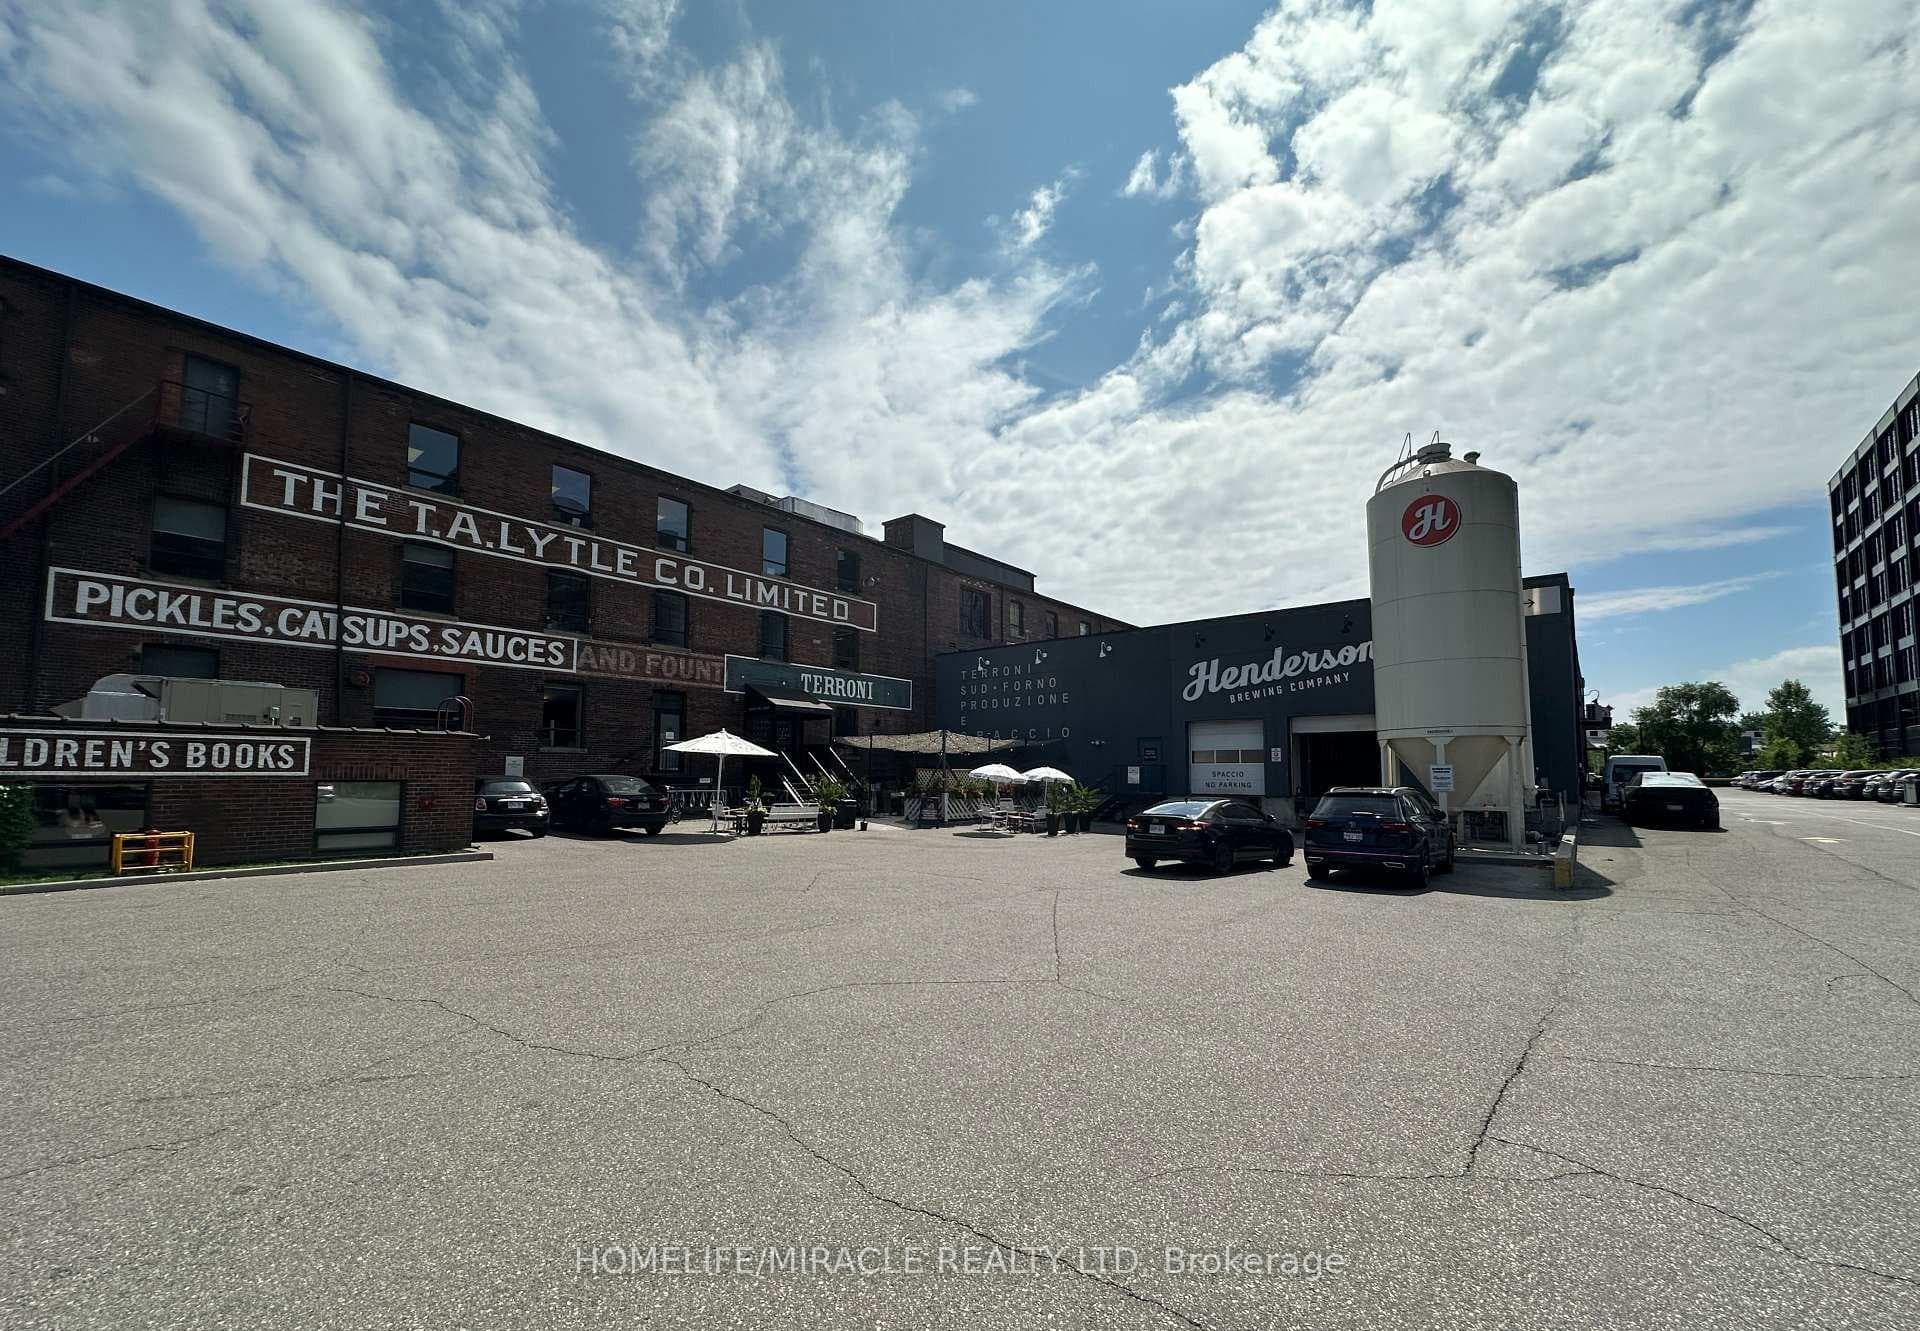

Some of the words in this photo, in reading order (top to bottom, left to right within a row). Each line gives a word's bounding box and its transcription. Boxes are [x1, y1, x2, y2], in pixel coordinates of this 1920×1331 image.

[274, 469, 388, 525] THE
[656, 558, 714, 592] CO.
[727, 574, 848, 621] LIMITED
[577, 645, 636, 672] AND
[961, 663, 1031, 680] TERRONI
[1183, 640, 1373, 701] Henderson
[801, 673, 873, 700] TERRONI
[1229, 684, 1283, 704] BREWING
[1290, 672, 1350, 692] COMPANY
[961, 693, 1069, 711] PRODUZIONE
[961, 716, 967, 725] E
[186, 742, 295, 769] BOOKS
